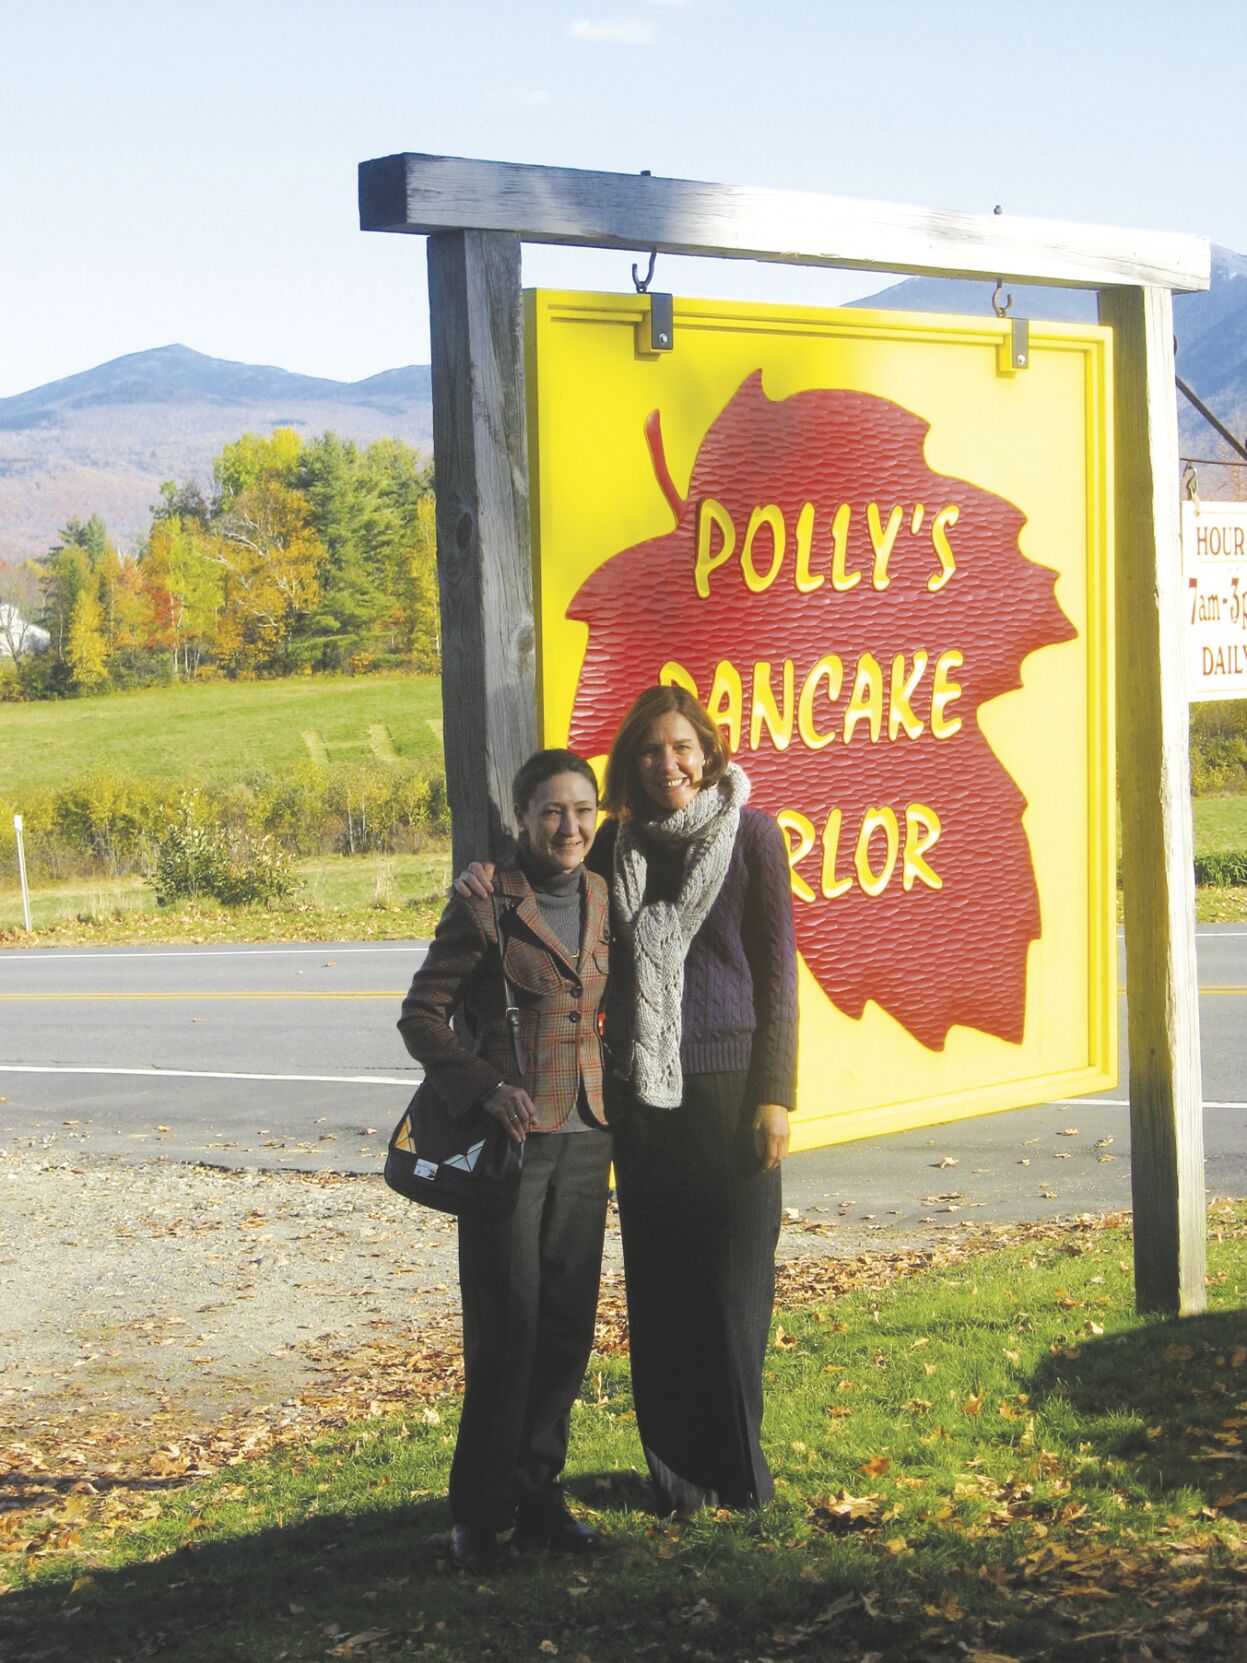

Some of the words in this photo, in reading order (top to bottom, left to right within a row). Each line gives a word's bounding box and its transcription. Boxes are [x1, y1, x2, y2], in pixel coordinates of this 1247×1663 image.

[694, 498, 960, 599] POLLY'S
[1196, 526, 1245, 556] HOUR
[776, 803, 943, 903] RLOR
